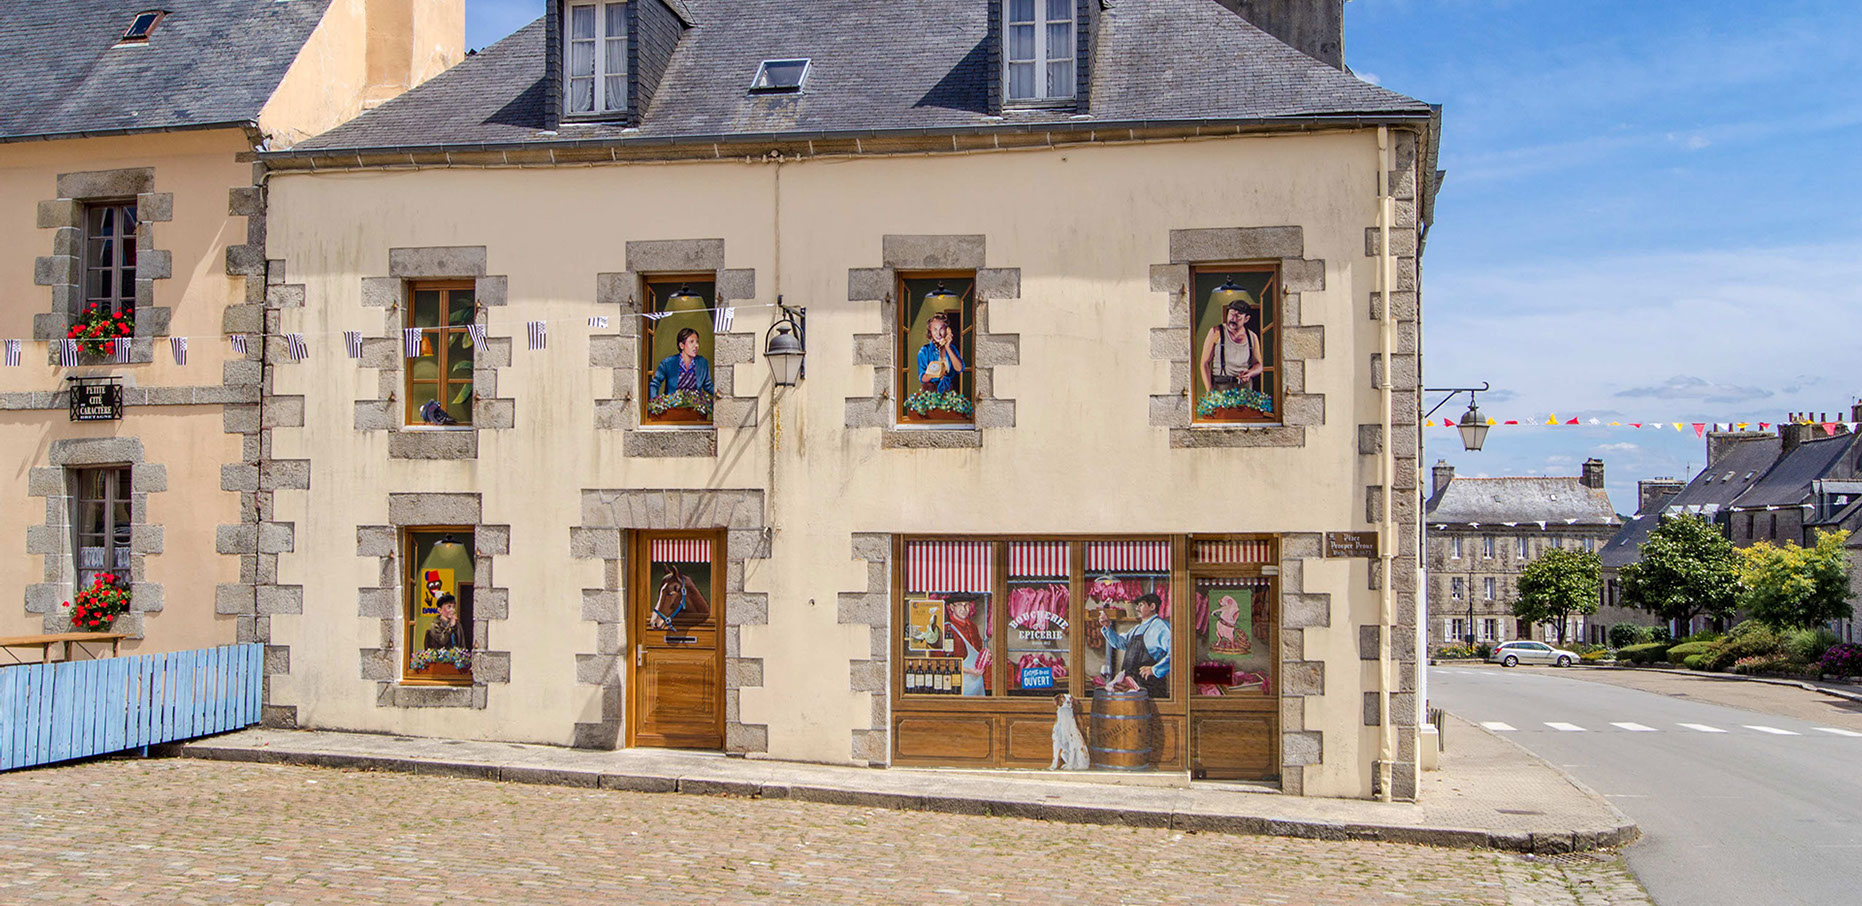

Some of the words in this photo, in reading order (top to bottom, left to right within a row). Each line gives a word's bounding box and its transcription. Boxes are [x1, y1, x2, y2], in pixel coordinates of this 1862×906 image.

[86, 386, 106, 394] PETITE
[89, 395, 103, 405] CITÉ
[80, 405, 112, 414] CARACTÈRE
[1344, 534, 1360, 542] Place
[1008, 611, 1069, 630] BOUCHERIE
[1019, 631, 1062, 640] EPICERIE
[1024, 676, 1050, 686] OUVERT
